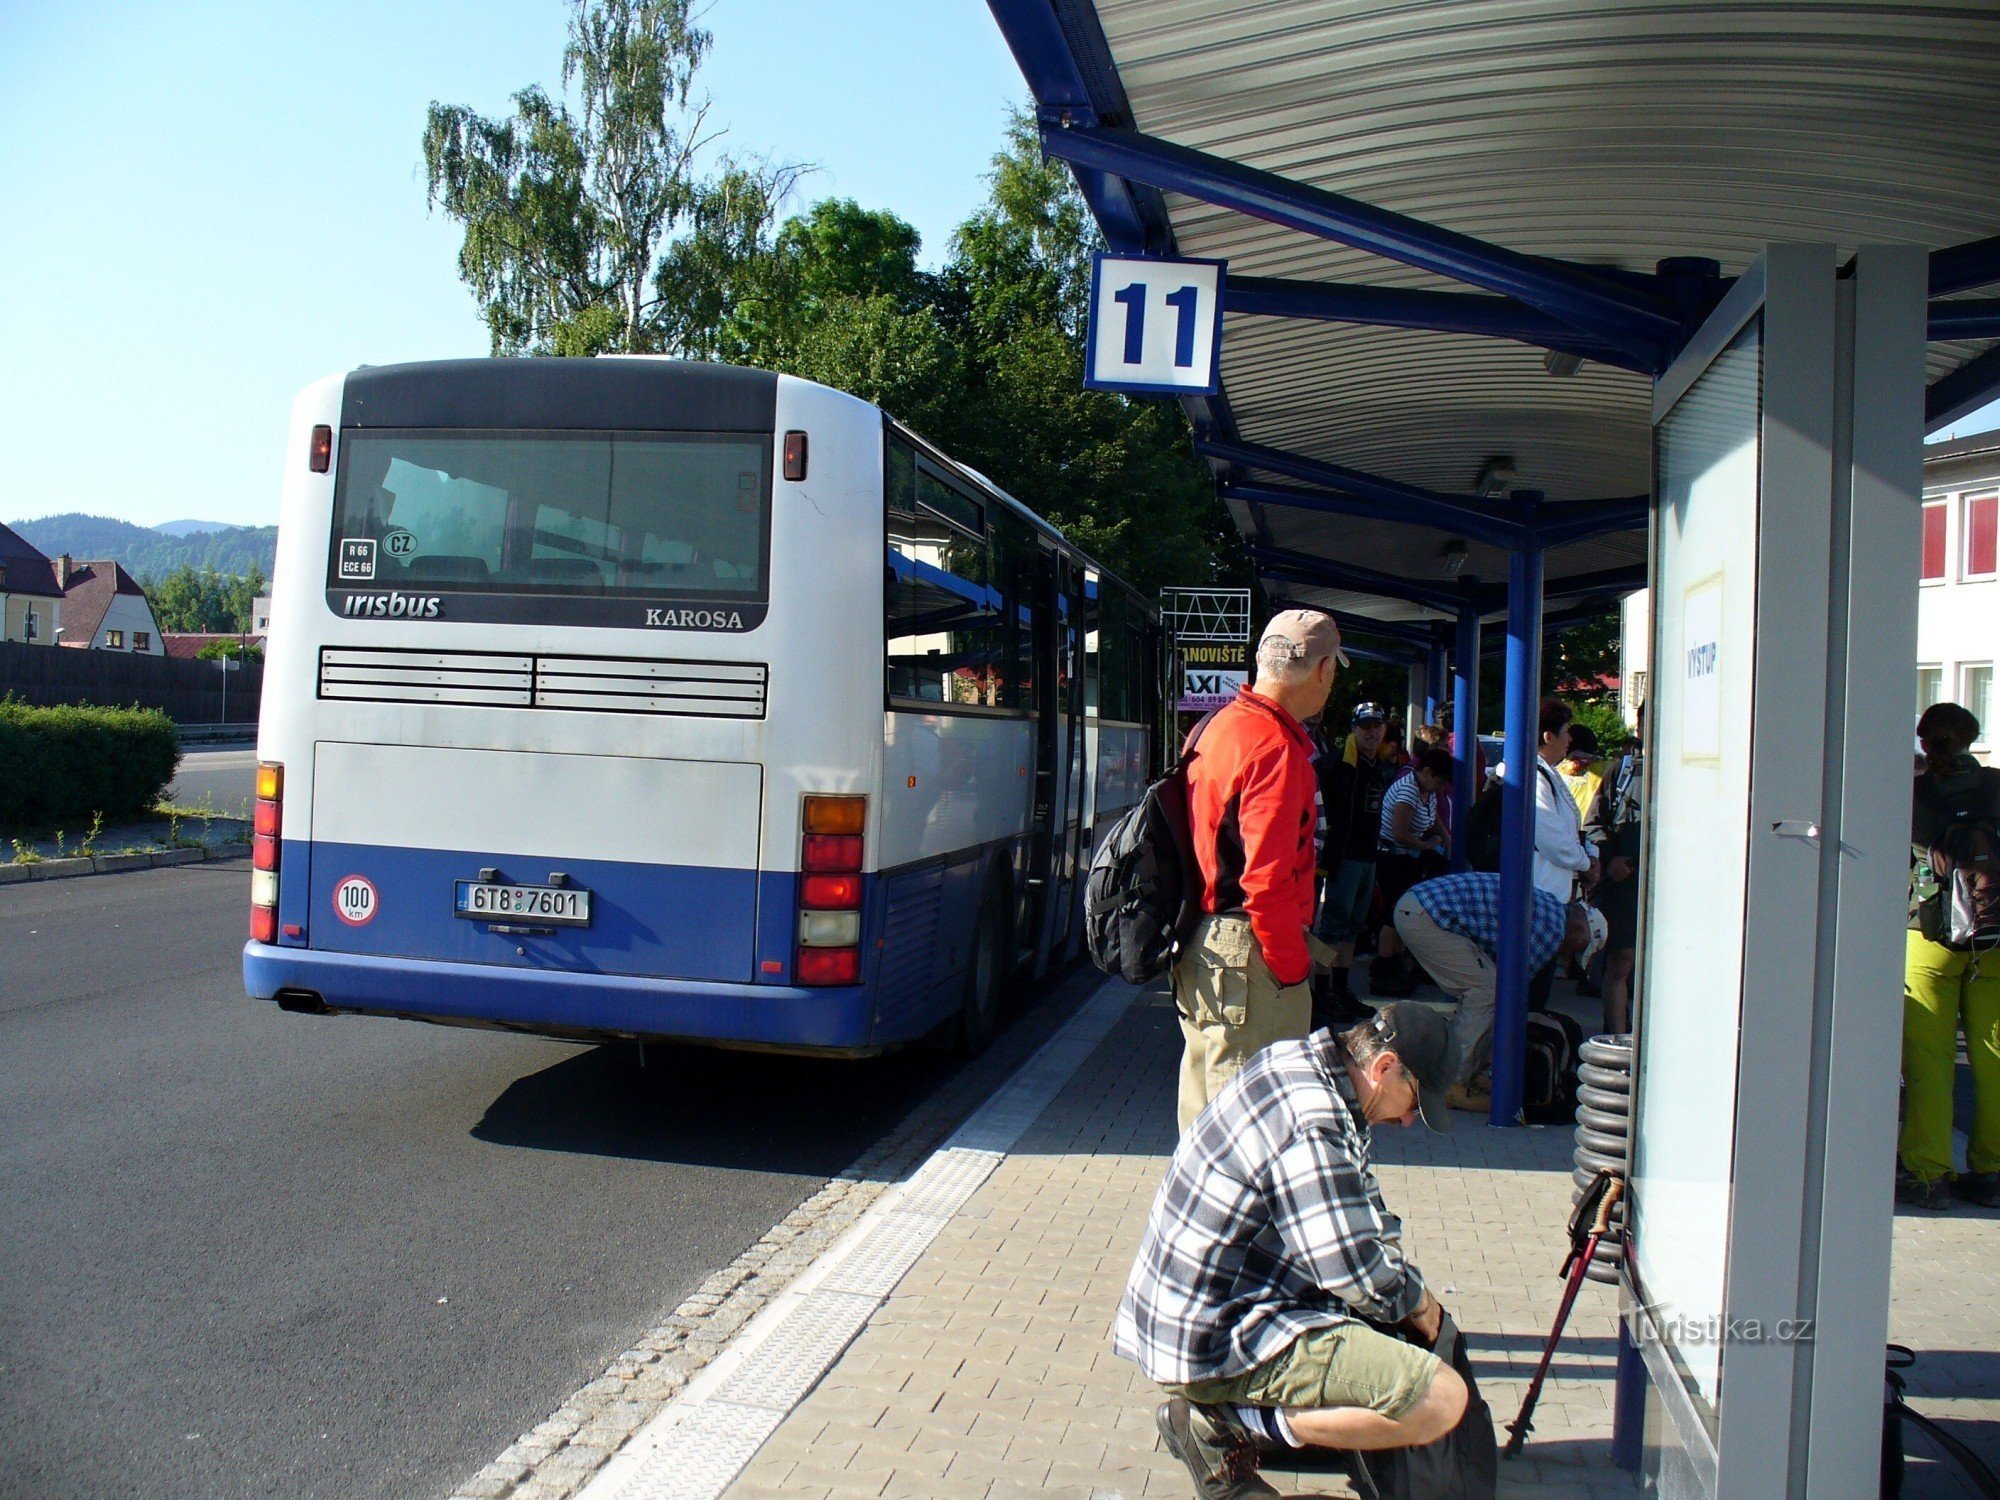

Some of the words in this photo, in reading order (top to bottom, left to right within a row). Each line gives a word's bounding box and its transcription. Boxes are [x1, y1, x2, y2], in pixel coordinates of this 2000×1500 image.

[1114, 283, 1198, 368] 11
[349, 545, 355, 556] R
[357, 545, 368, 556] 66
[391, 536, 410, 553] CZ
[343, 562, 359, 572] ECE
[361, 562, 372, 573] 66
[645, 608, 743, 629] KAROSA
[1181, 645, 1245, 662] ANOVIŠTĚ
[1687, 640, 1716, 679] VÝSTUP
[1186, 675, 1220, 694] AXI
[343, 886, 369, 908] 100
[474, 887, 510, 910] 6T8
[527, 891, 577, 915] 7601
[349, 909, 363, 918] km
